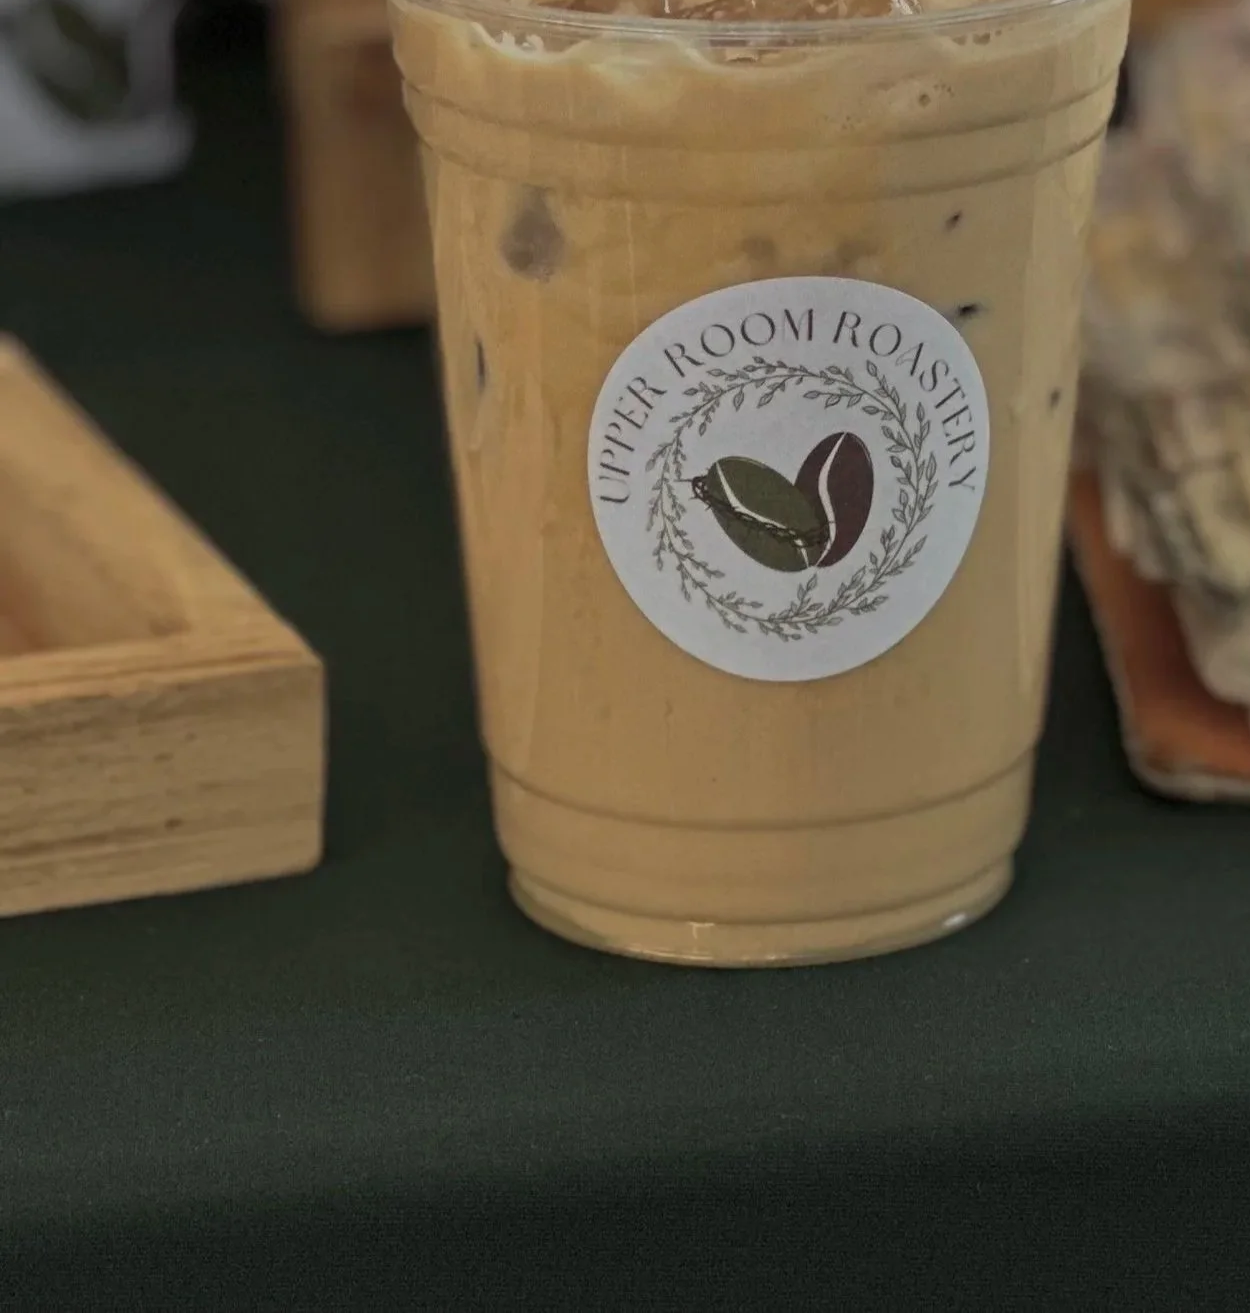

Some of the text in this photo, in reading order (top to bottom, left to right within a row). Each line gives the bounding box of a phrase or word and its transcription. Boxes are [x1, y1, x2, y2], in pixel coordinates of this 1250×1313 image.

[597, 308, 978, 504] UPPER ROOM ROASTERY
